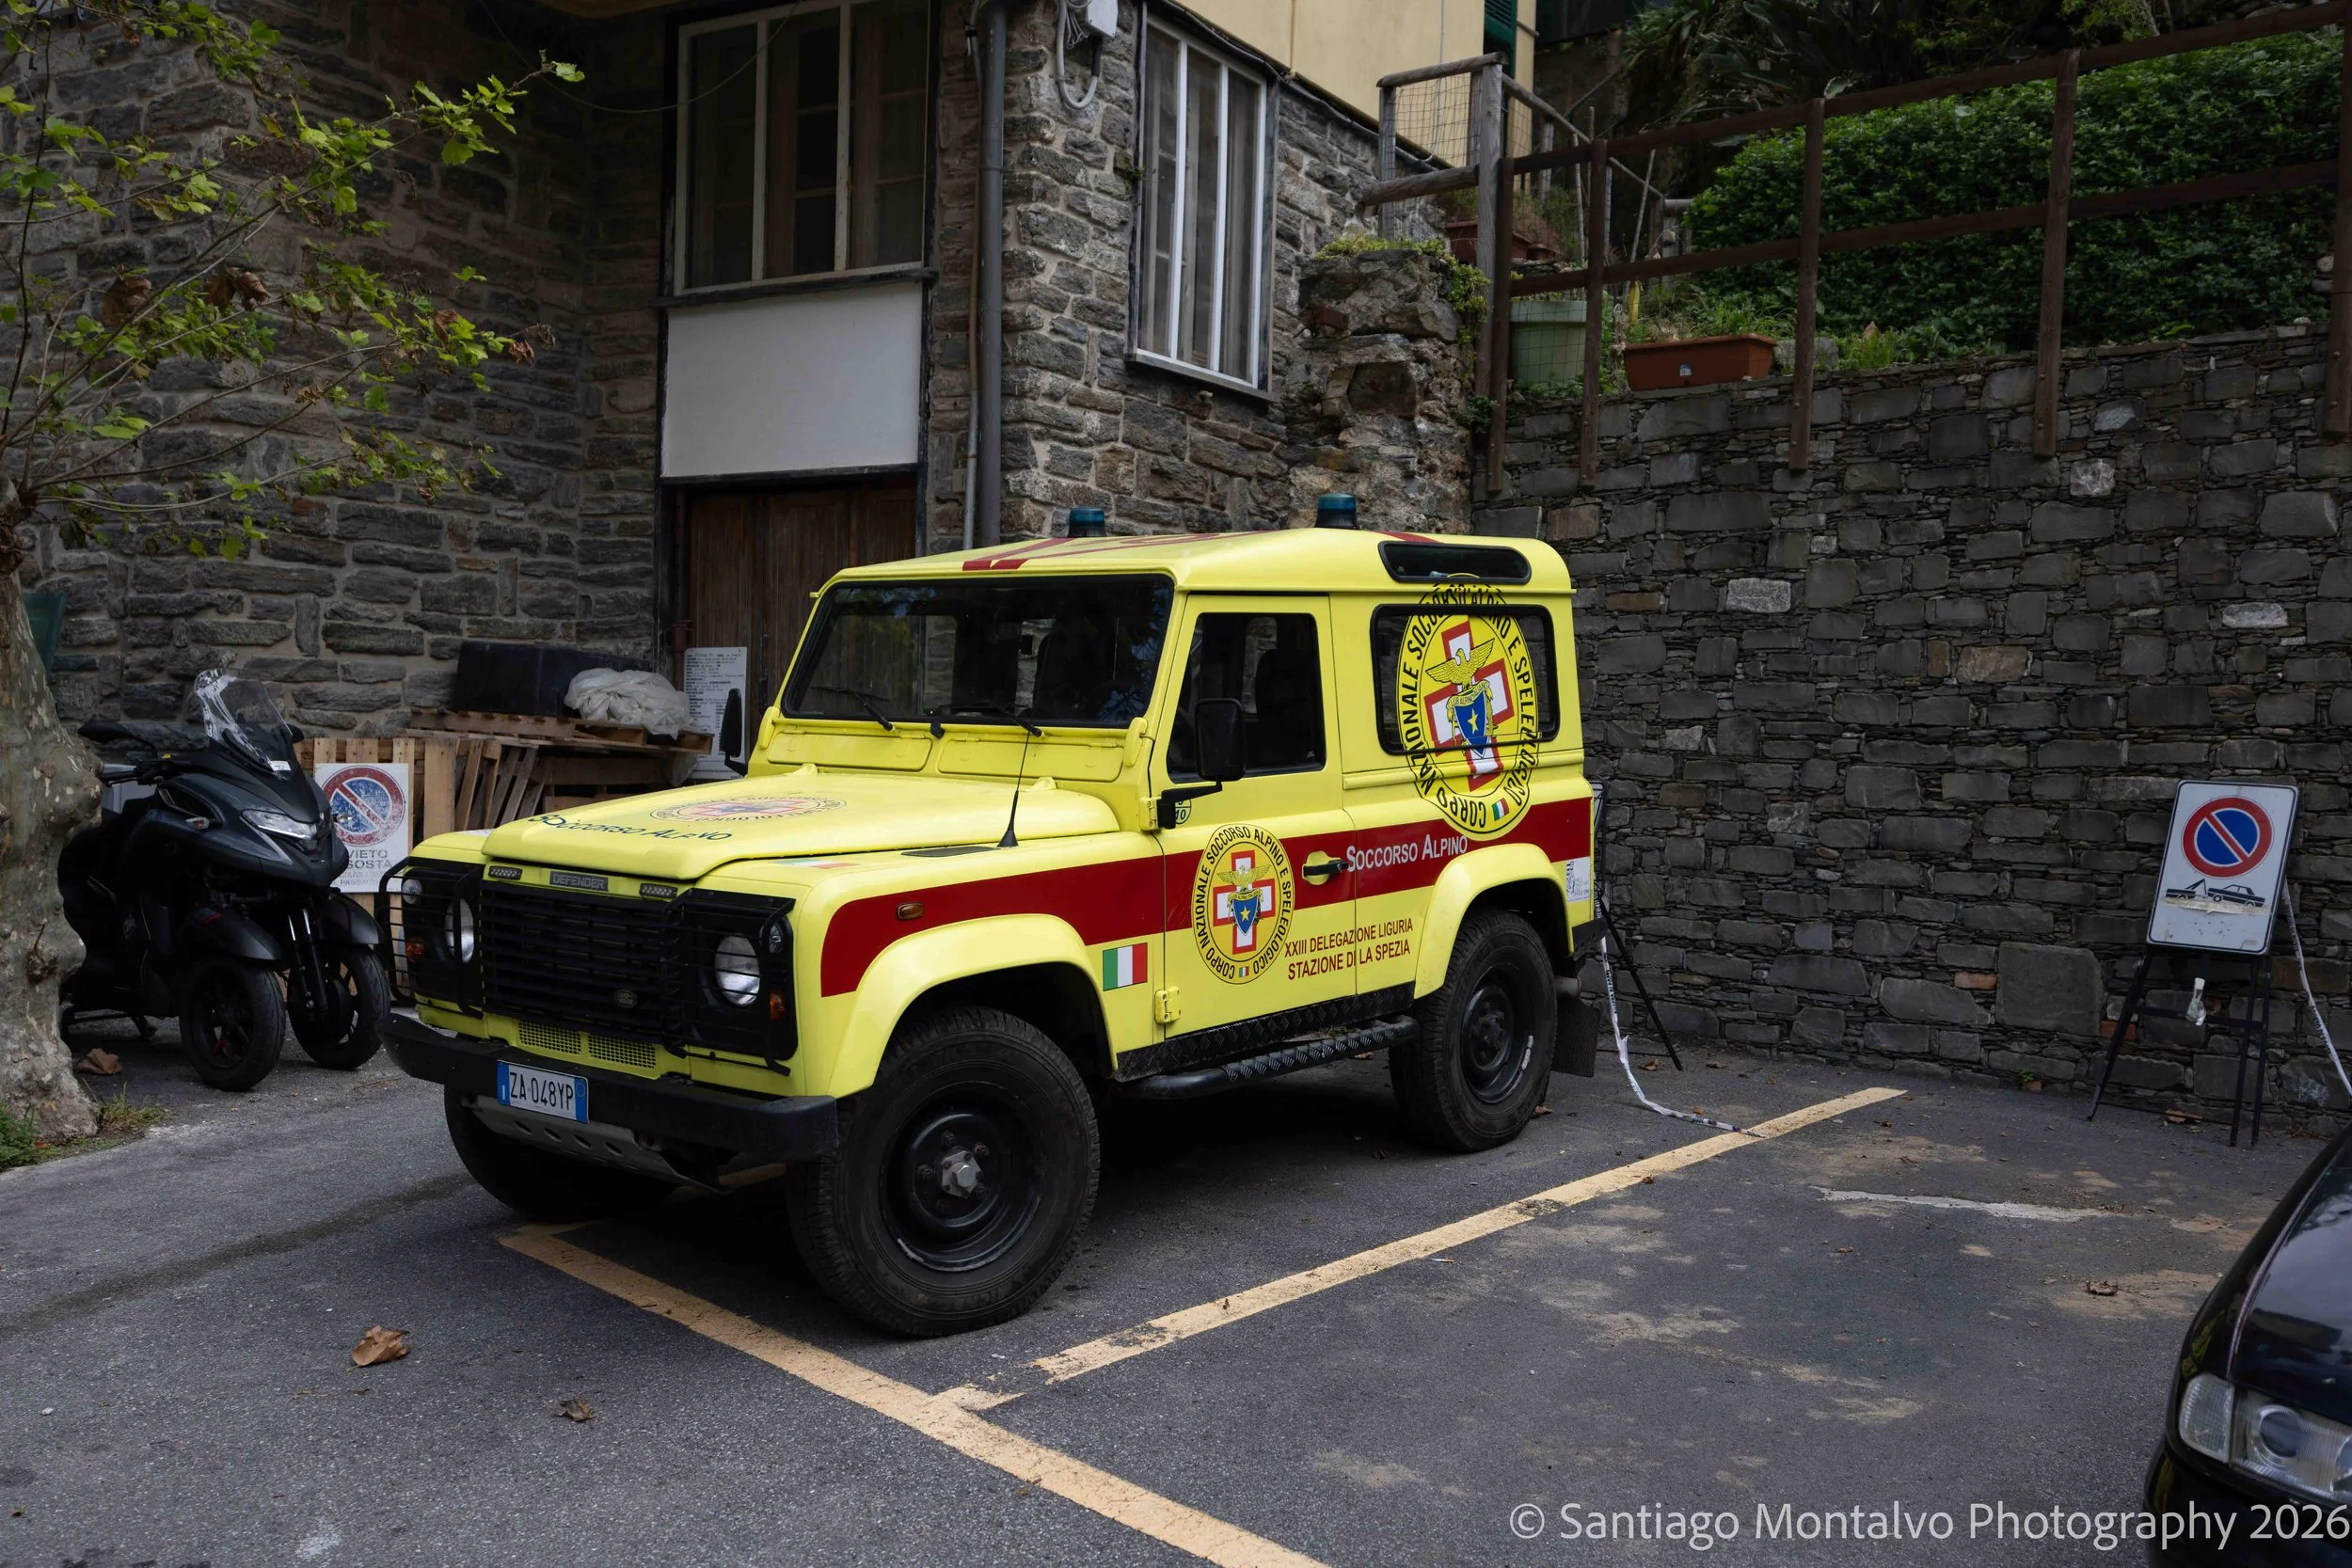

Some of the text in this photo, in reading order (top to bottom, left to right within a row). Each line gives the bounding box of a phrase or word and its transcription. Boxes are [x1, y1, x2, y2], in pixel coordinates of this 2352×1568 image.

[1437, 786, 1486, 829] CORPO
[1508, 636, 1521, 657] E
[349, 849, 389, 859] VIETO
[1205, 825, 1251, 864] SOCCORSO
[1254, 828, 1284, 866] ALPINO
[552, 873, 605, 890] DEFENDER
[1279, 868, 1289, 878] E
[1195, 868, 1211, 949] NAZIONALE
[1253, 880, 1293, 975] SPELEOLOGICO
[1284, 917, 1414, 958] XXIII DELEGAZIONE LIGURIA
[1205, 950, 1235, 980] CORPO
[1288, 939, 1411, 981] STAZIONE DI LA SPEZIA
[509, 1071, 527, 1101] ZA
[531, 1077, 574, 1110] 048YP
